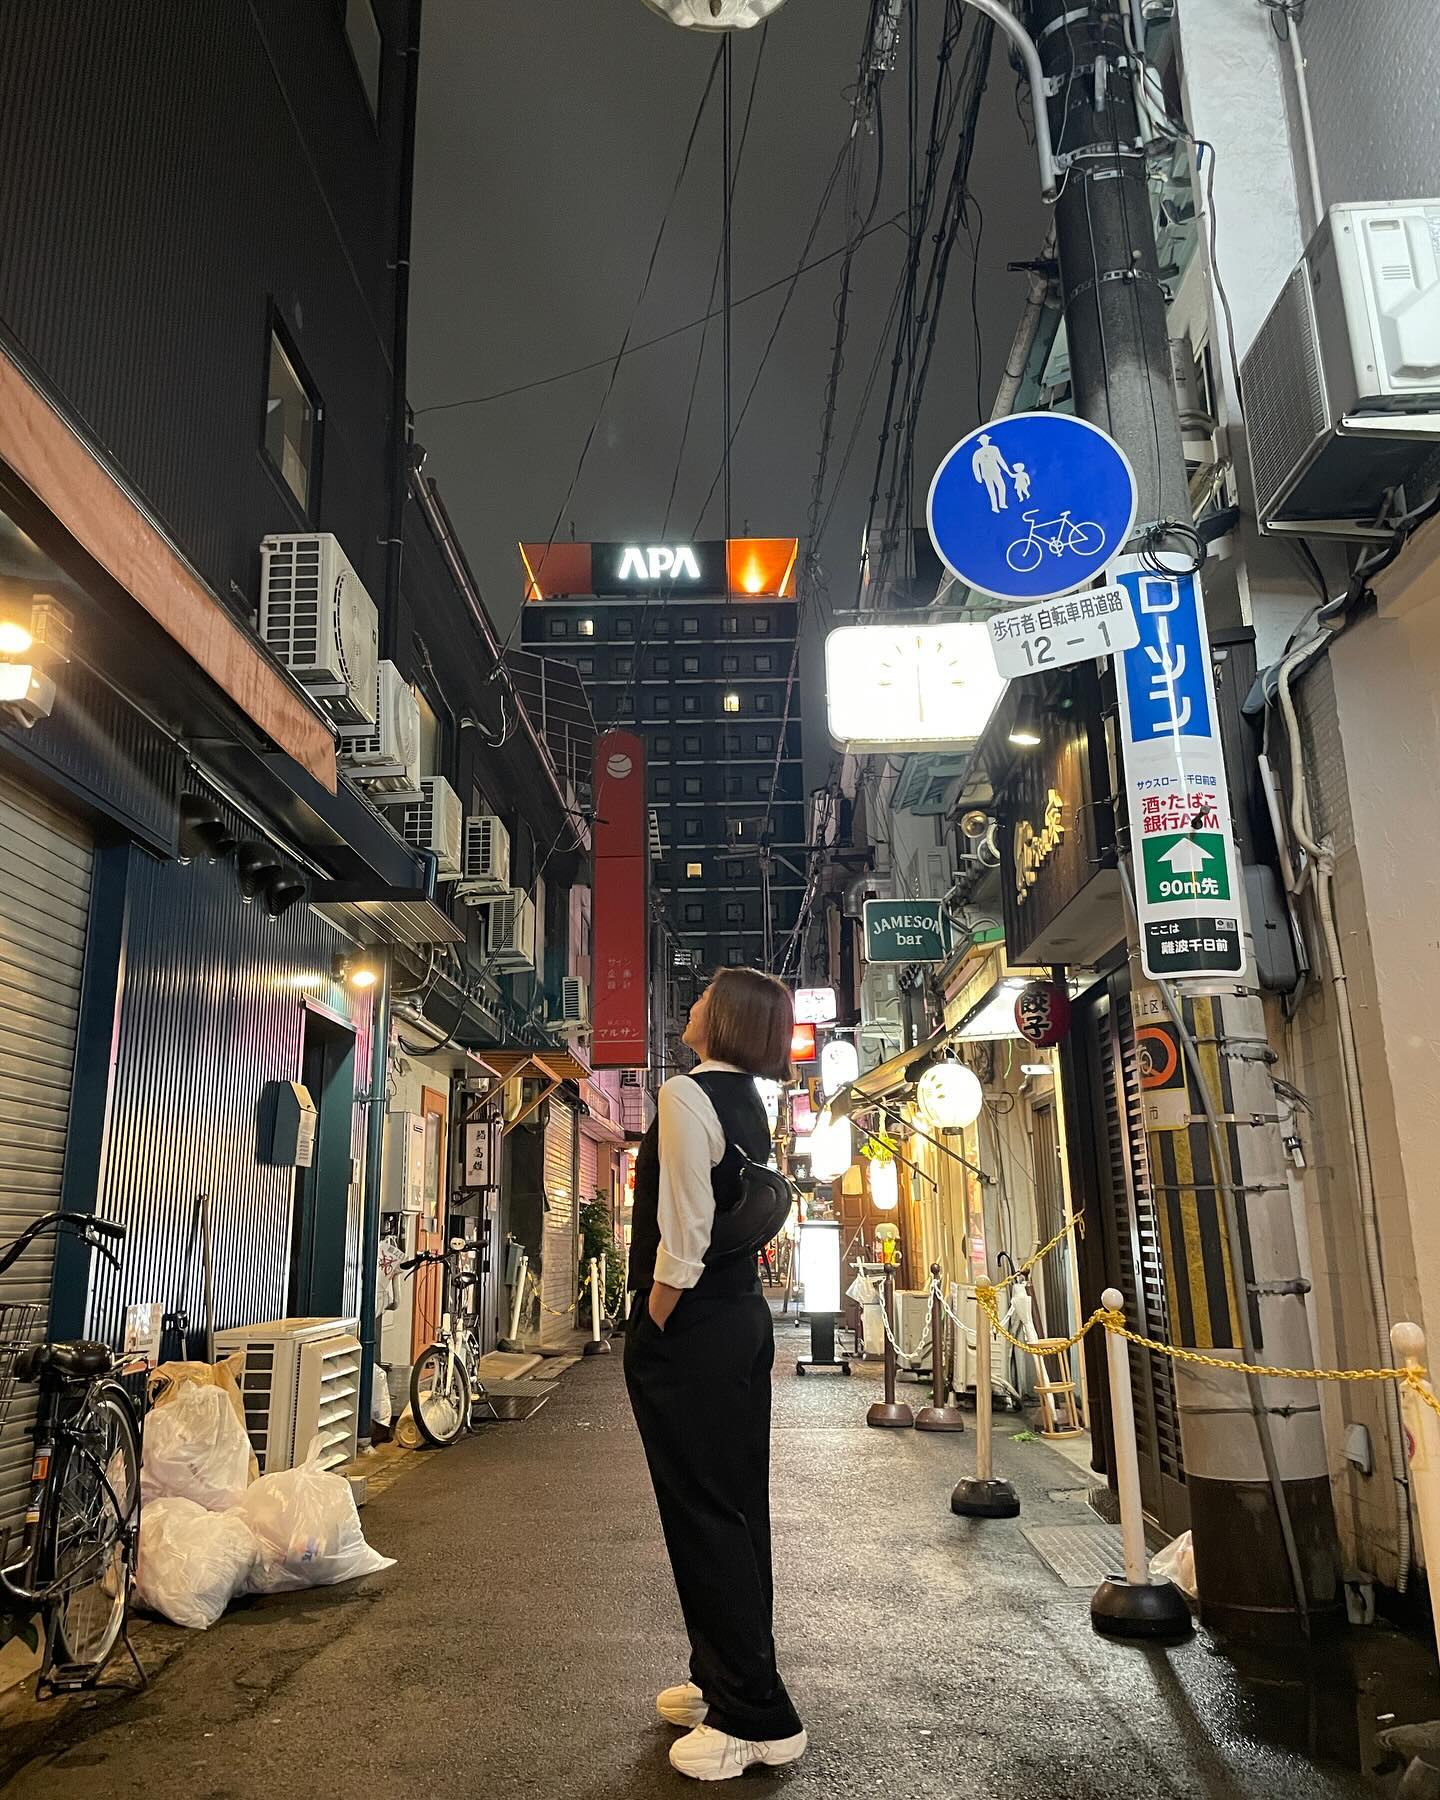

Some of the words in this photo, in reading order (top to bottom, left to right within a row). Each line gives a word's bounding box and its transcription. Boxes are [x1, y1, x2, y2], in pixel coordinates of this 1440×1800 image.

[618, 546, 702, 580] APA
[1138, 575, 1192, 733] ローソン
[1136, 774, 1217, 791] サウスロー千日前店
[1159, 877, 1219, 897] 90m先
[1150, 922, 1181, 936] ここは
[896, 932, 923, 946] bar
[1161, 938, 1229, 955] 難波千日前
[1021, 991, 1050, 1038] 餃子
[598, 1026, 641, 1038] マルサン
